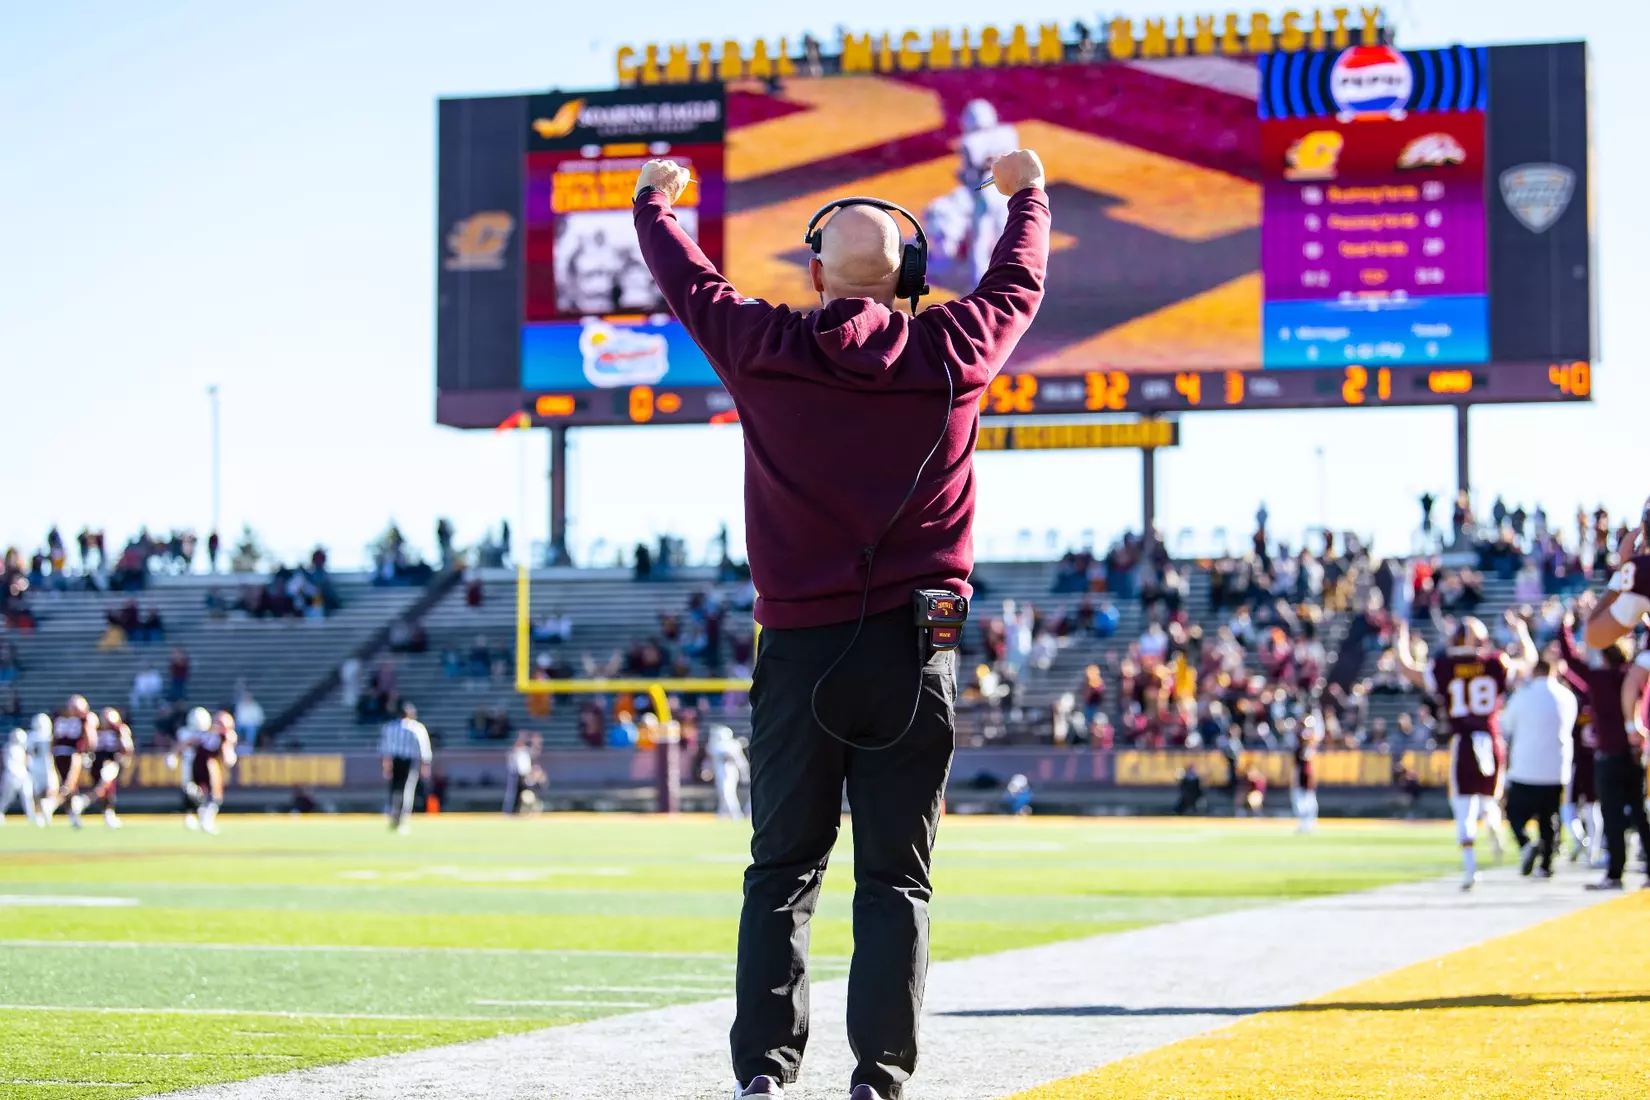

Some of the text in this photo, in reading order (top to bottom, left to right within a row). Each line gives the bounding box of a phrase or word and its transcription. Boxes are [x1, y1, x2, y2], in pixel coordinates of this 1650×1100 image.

[616, 7, 1382, 84] CENTRAL MICHIGAN UNIVERSITY
[1447, 675, 1498, 718] 18
